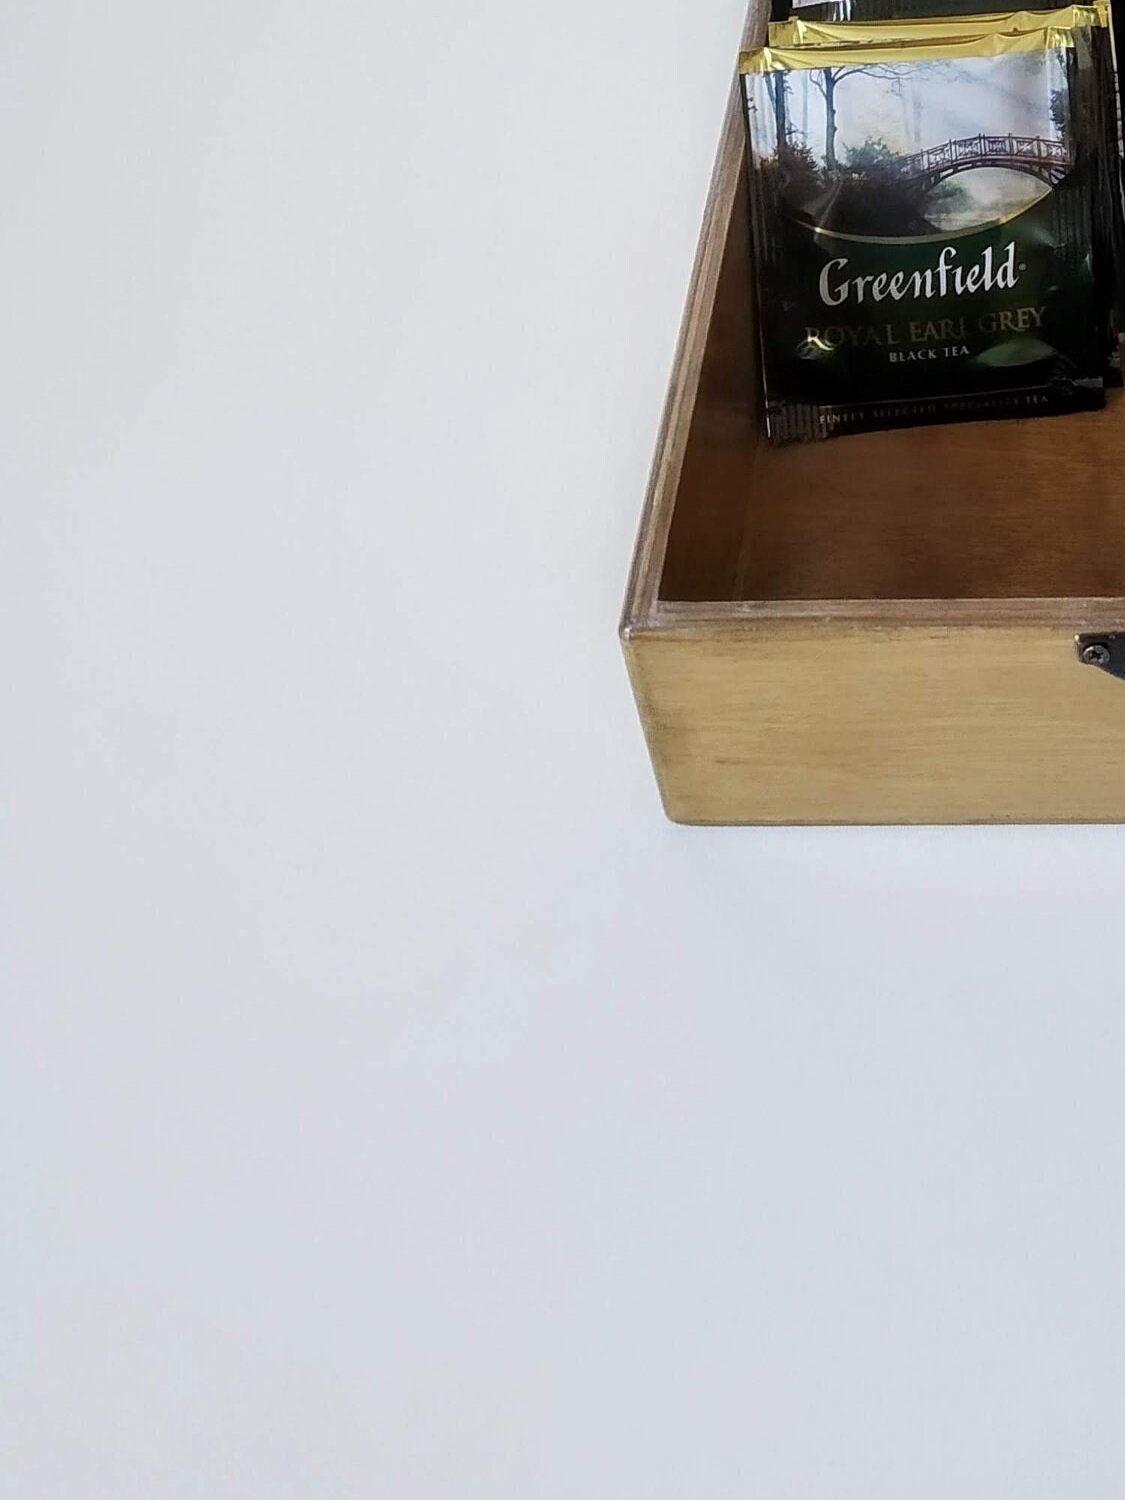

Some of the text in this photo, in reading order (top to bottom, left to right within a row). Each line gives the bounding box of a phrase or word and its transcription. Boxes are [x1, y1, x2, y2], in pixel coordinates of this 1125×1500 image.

[818, 240, 1021, 308] Greenfield
[804, 322, 901, 352] ROYAL
[977, 306, 1048, 336] GREY
[888, 344, 971, 364] BLACK TEA
[1025, 394, 1050, 406] TEA
